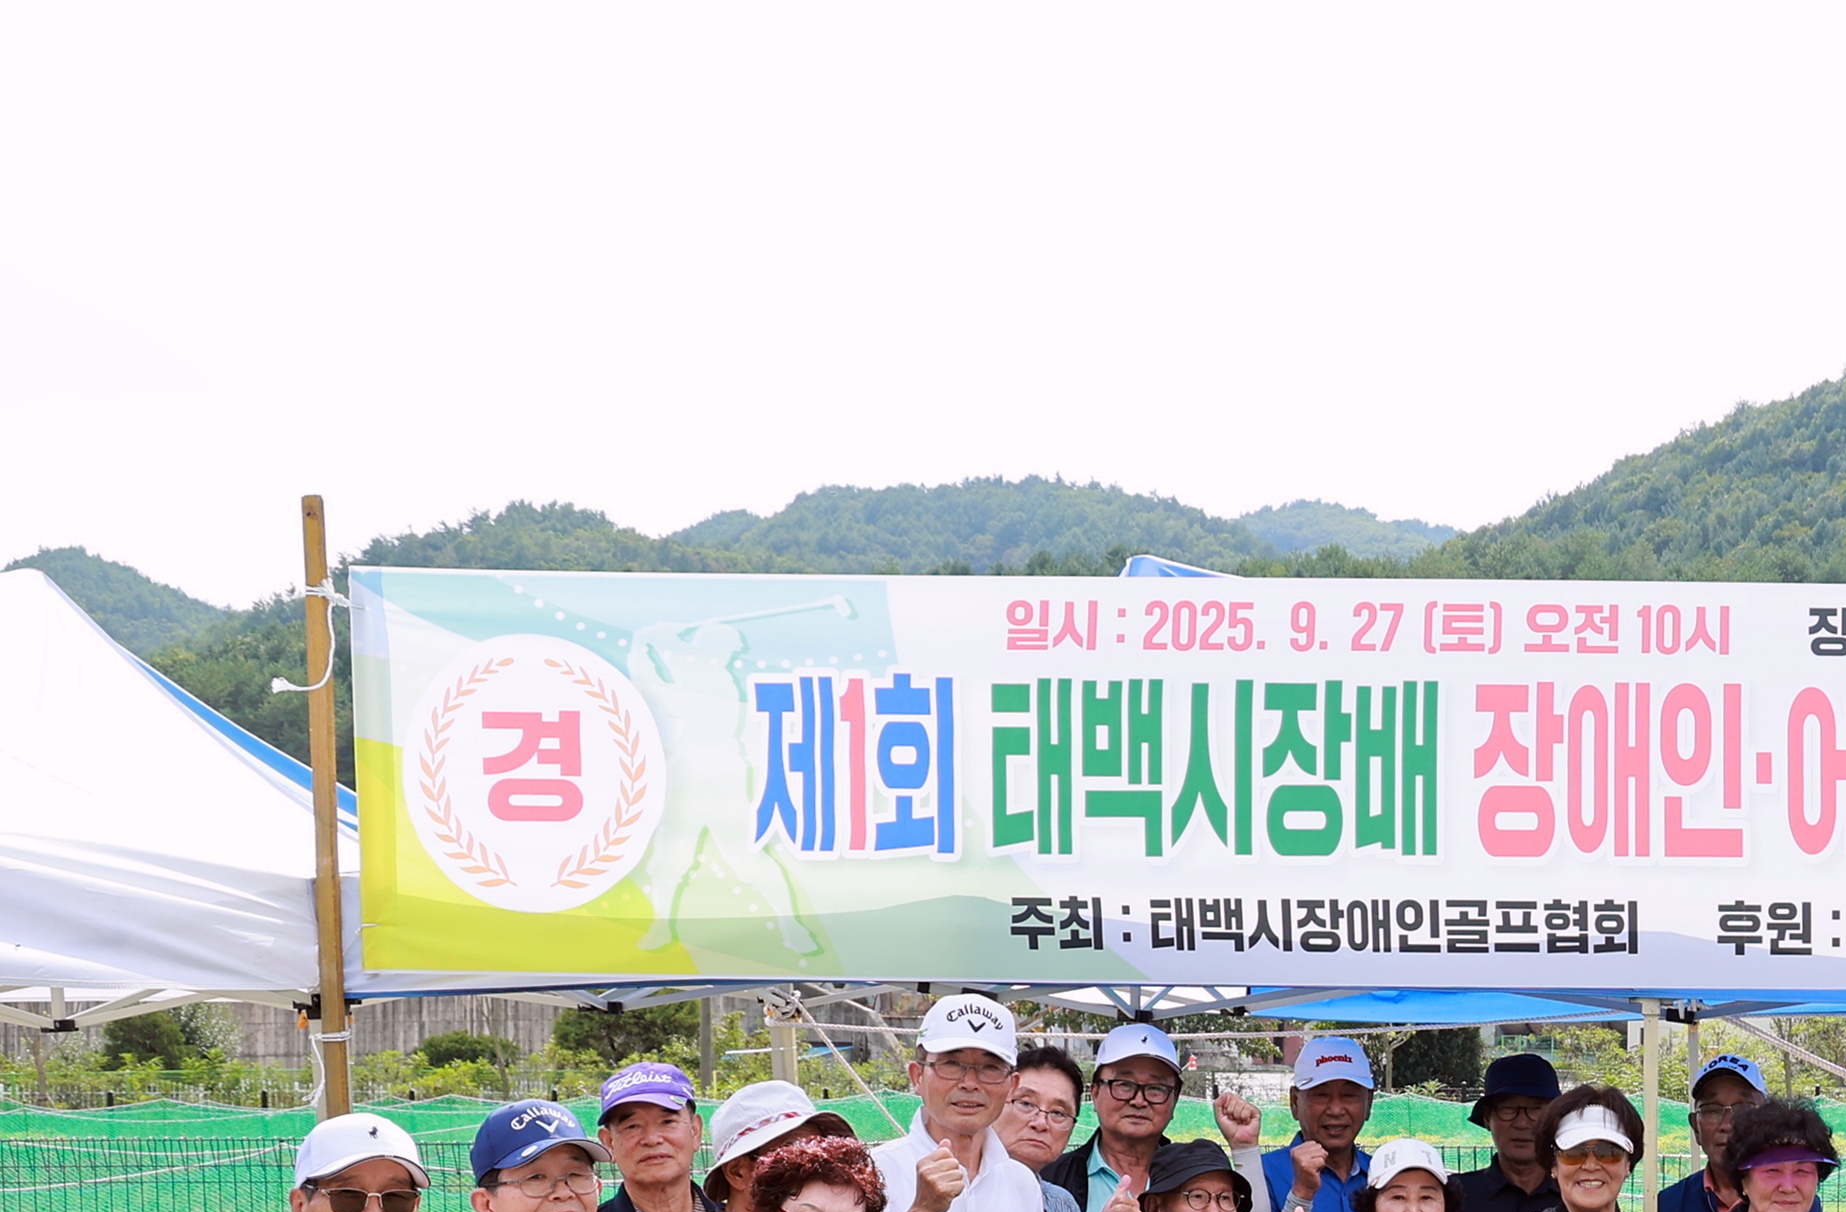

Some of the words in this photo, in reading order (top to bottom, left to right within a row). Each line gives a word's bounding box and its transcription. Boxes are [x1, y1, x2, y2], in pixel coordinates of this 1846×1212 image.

[1007, 600, 1098, 651] 일시
[1143, 600, 1265, 652] 2025.
[1291, 601, 1328, 652] 9.
[1352, 601, 1404, 652] 27
[1424, 601, 1502, 654] (토)
[1525, 604, 1619, 654] 오전
[1638, 604, 1730, 656] 10시
[481, 710, 584, 823] 경
[755, 673, 955, 854] 제1회
[991, 677, 1438, 857] 태백시장배
[1010, 896, 1104, 952] 주최
[1150, 898, 1640, 956] 태백시장애인골프협회
[1717, 900, 1813, 957] 후원
[946, 1003, 1004, 1030] Callaway
[604, 1071, 672, 1100] Titleist
[1315, 1054, 1353, 1067] phoenix
[510, 1106, 576, 1130] Callaway
